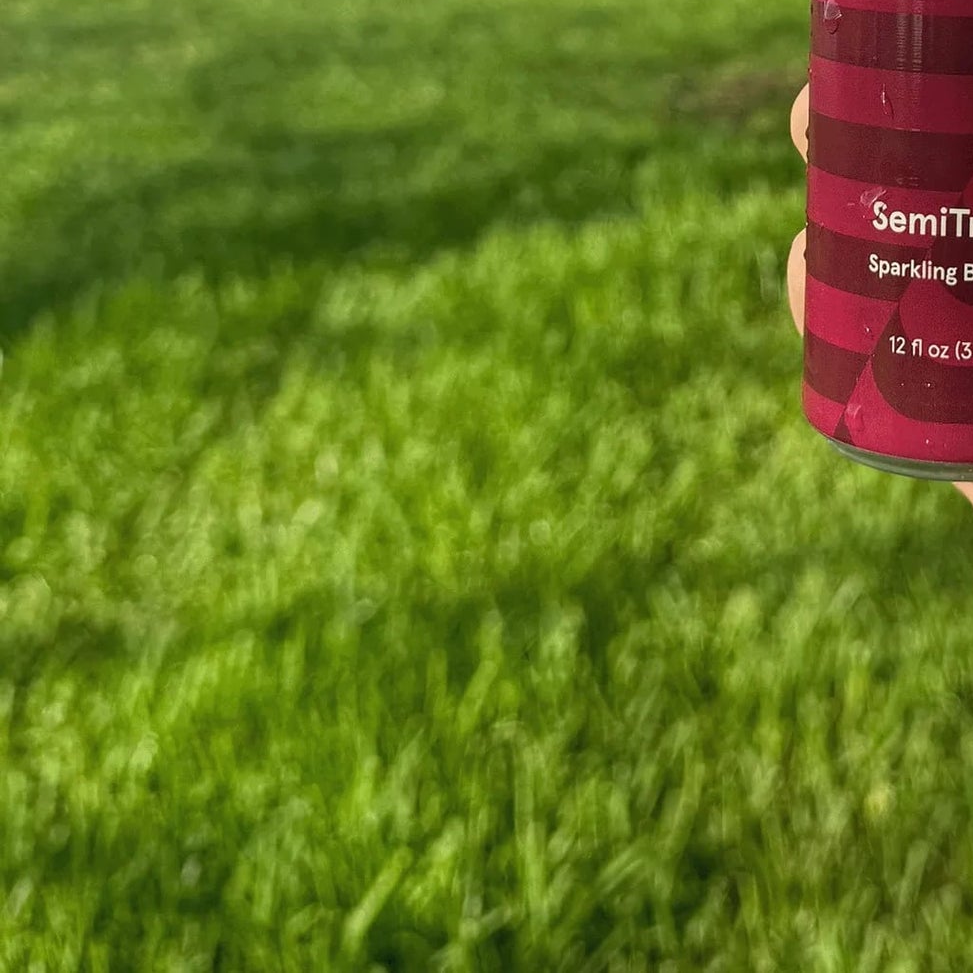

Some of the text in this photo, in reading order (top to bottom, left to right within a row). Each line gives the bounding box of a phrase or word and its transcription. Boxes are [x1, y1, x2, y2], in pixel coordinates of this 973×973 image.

[868, 253, 957, 285] Sparkling
[888, 335, 906, 355] 12
[911, 339, 922, 357] fl
[928, 343, 949, 359] oz
